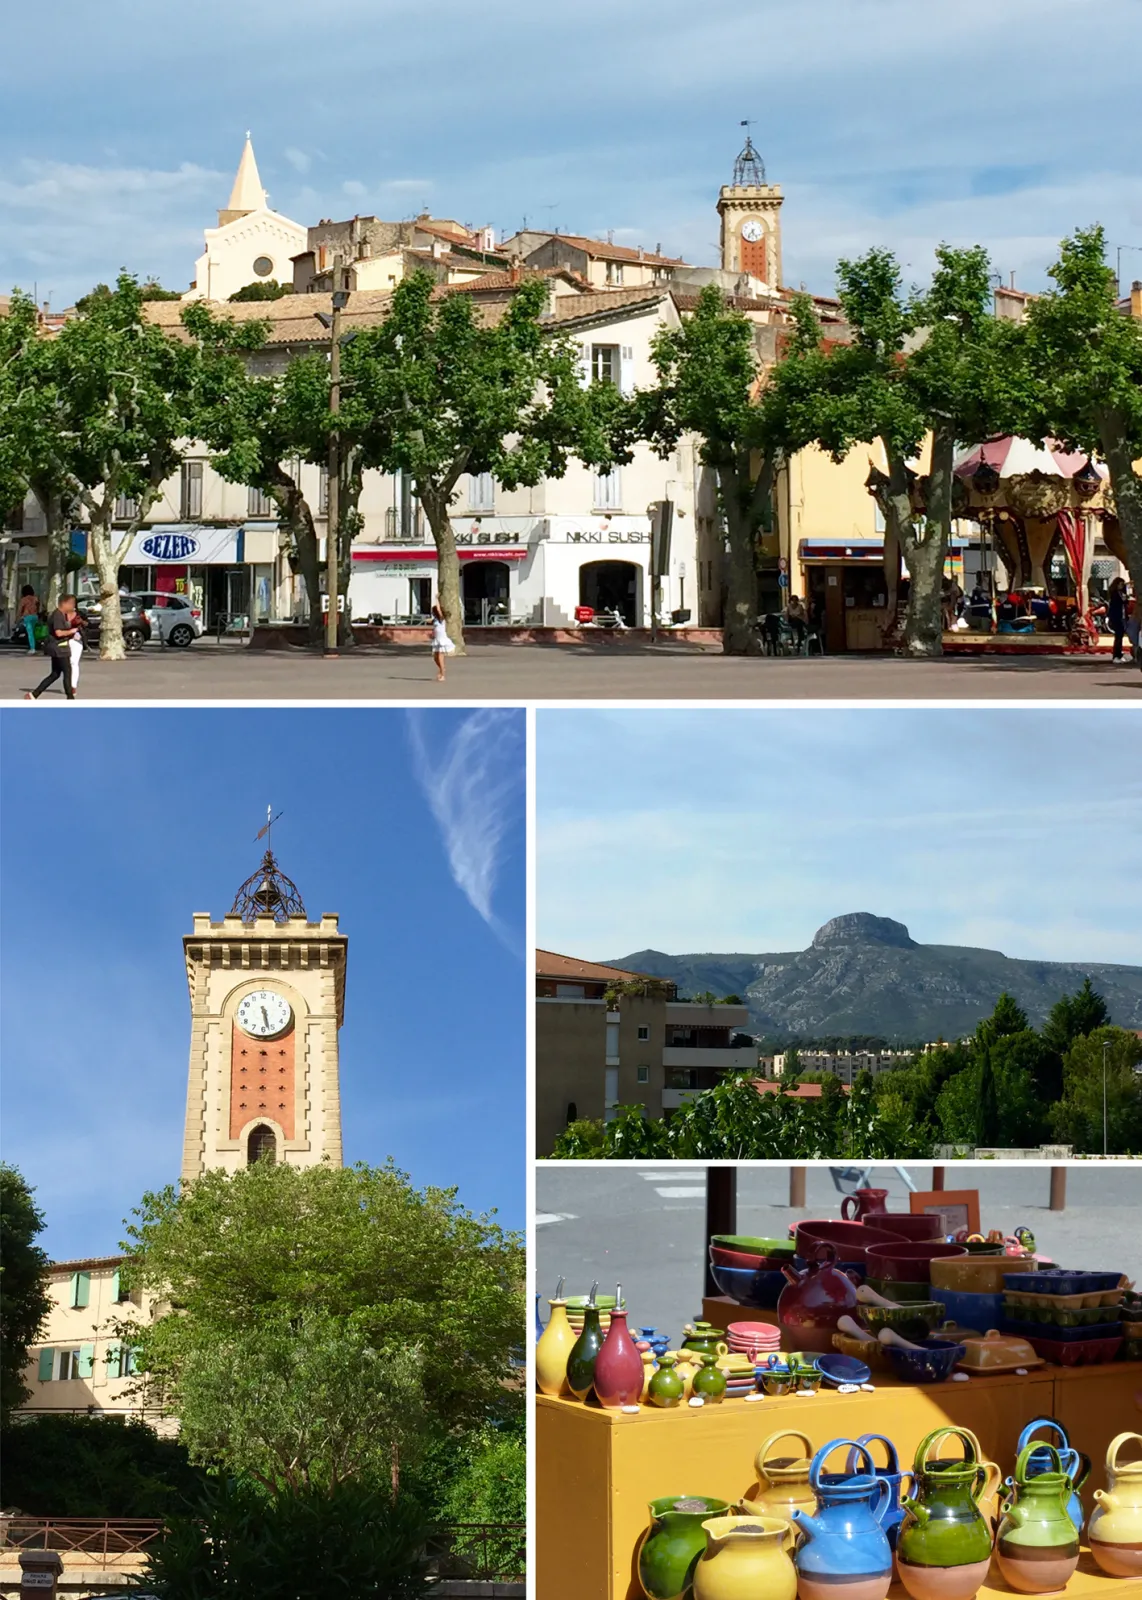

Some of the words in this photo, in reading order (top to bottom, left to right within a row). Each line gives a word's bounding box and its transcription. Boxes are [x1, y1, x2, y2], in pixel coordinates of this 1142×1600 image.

[454, 533, 473, 543] KKI
[566, 531, 602, 543] NIKKI
[608, 531, 652, 543] SUSH
[143, 535, 197, 559] BEZERT
